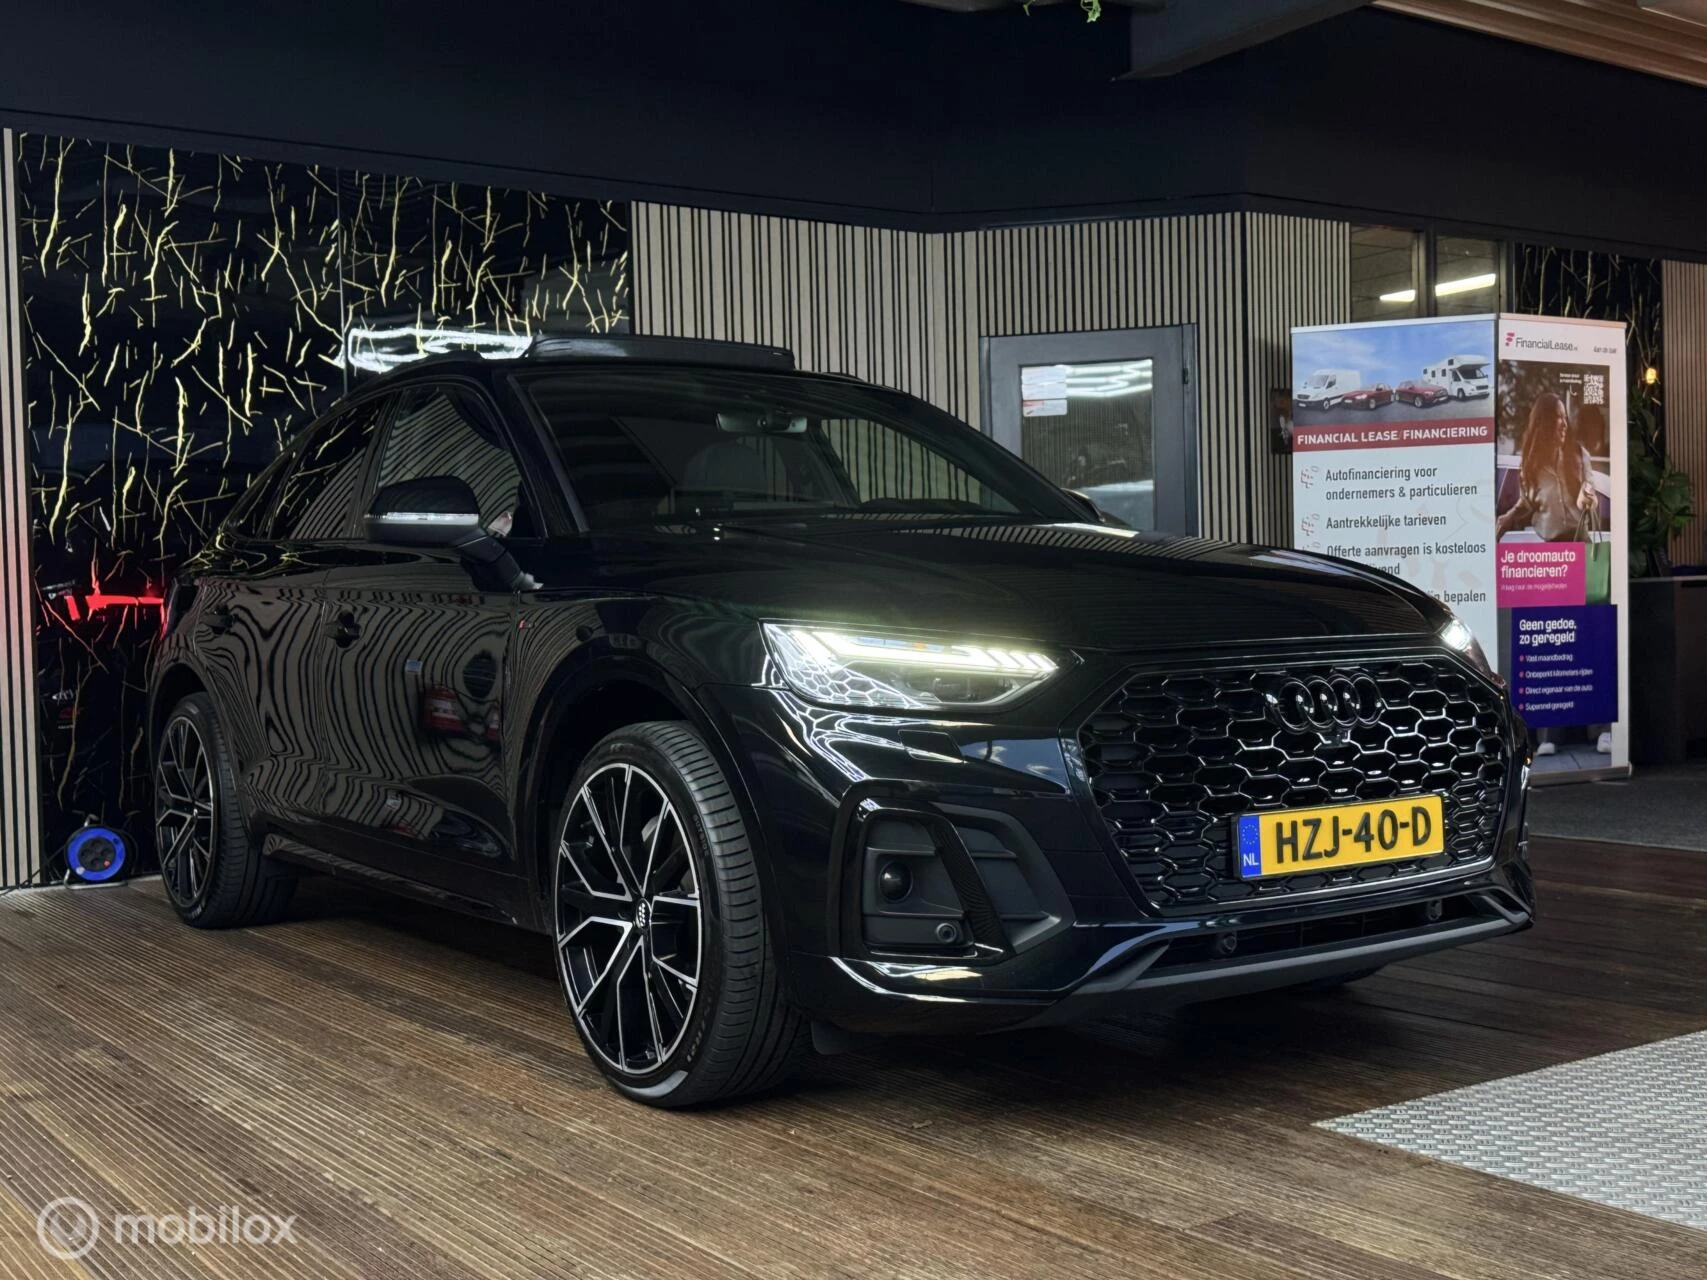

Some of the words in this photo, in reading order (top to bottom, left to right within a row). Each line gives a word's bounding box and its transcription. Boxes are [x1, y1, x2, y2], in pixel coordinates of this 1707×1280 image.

[1297, 433, 1358, 445] FINANCIAL
[1361, 430, 1398, 442] LEASE
[1403, 426, 1488, 440] FINANCIERING
[1325, 467, 1411, 482] Autofinanciering
[1414, 467, 1438, 478] voor
[1325, 486, 1395, 500] ondernemers
[1398, 486, 1406, 498] &
[1409, 484, 1477, 500] particulieren
[1326, 515, 1401, 530] Aantrekkelijke
[1404, 515, 1446, 527] tarieven
[1327, 545, 1361, 558] Offerte
[1365, 545, 1419, 558] aanvragen
[1423, 542, 1432, 555] is
[1435, 541, 1486, 554] kosteloos
[1501, 550, 1515, 563] Je
[1517, 550, 1576, 563] droomauto
[1501, 564, 1568, 578] financieren?
[1443, 590, 1486, 604] bepalen
[1519, 619, 1543, 631] Geen
[1519, 633, 1530, 645] zo
[1532, 631, 1575, 647] geregeld
[1243, 853, 1259, 867] NL
[1275, 806, 1432, 864] HZJ-40-D
